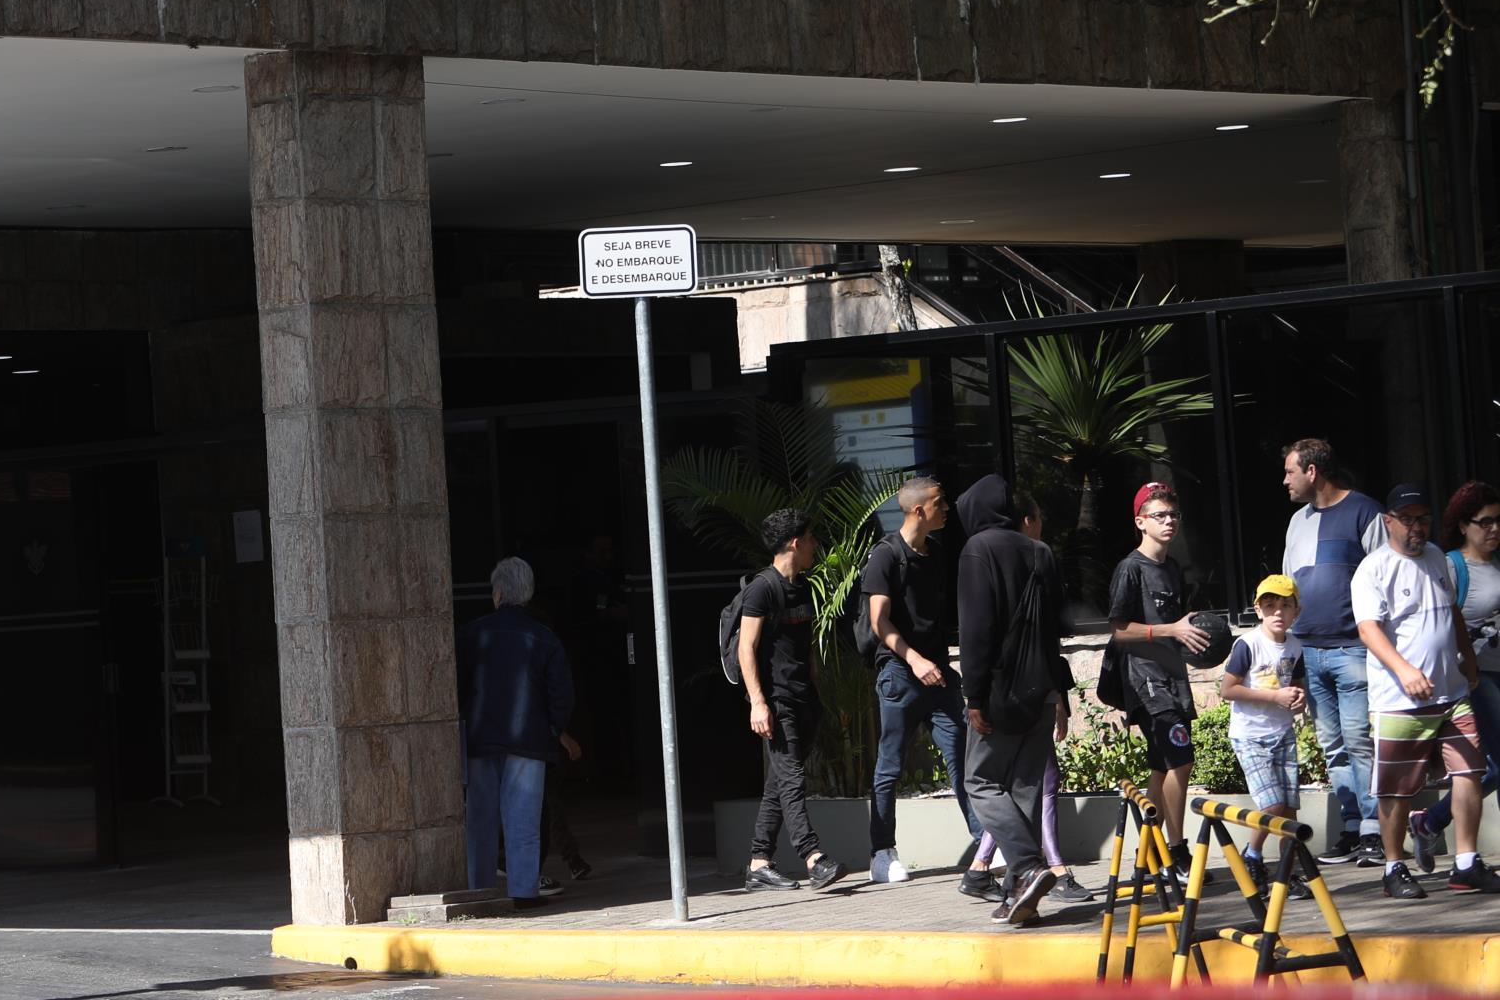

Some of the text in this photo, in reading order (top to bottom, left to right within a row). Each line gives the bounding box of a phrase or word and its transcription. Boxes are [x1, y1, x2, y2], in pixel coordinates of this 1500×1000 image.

[604, 240, 672, 251] SEJA BREVE
[597, 256, 680, 268] NO EMBARQUE
[591, 272, 687, 285] E DESEMBARQUE
